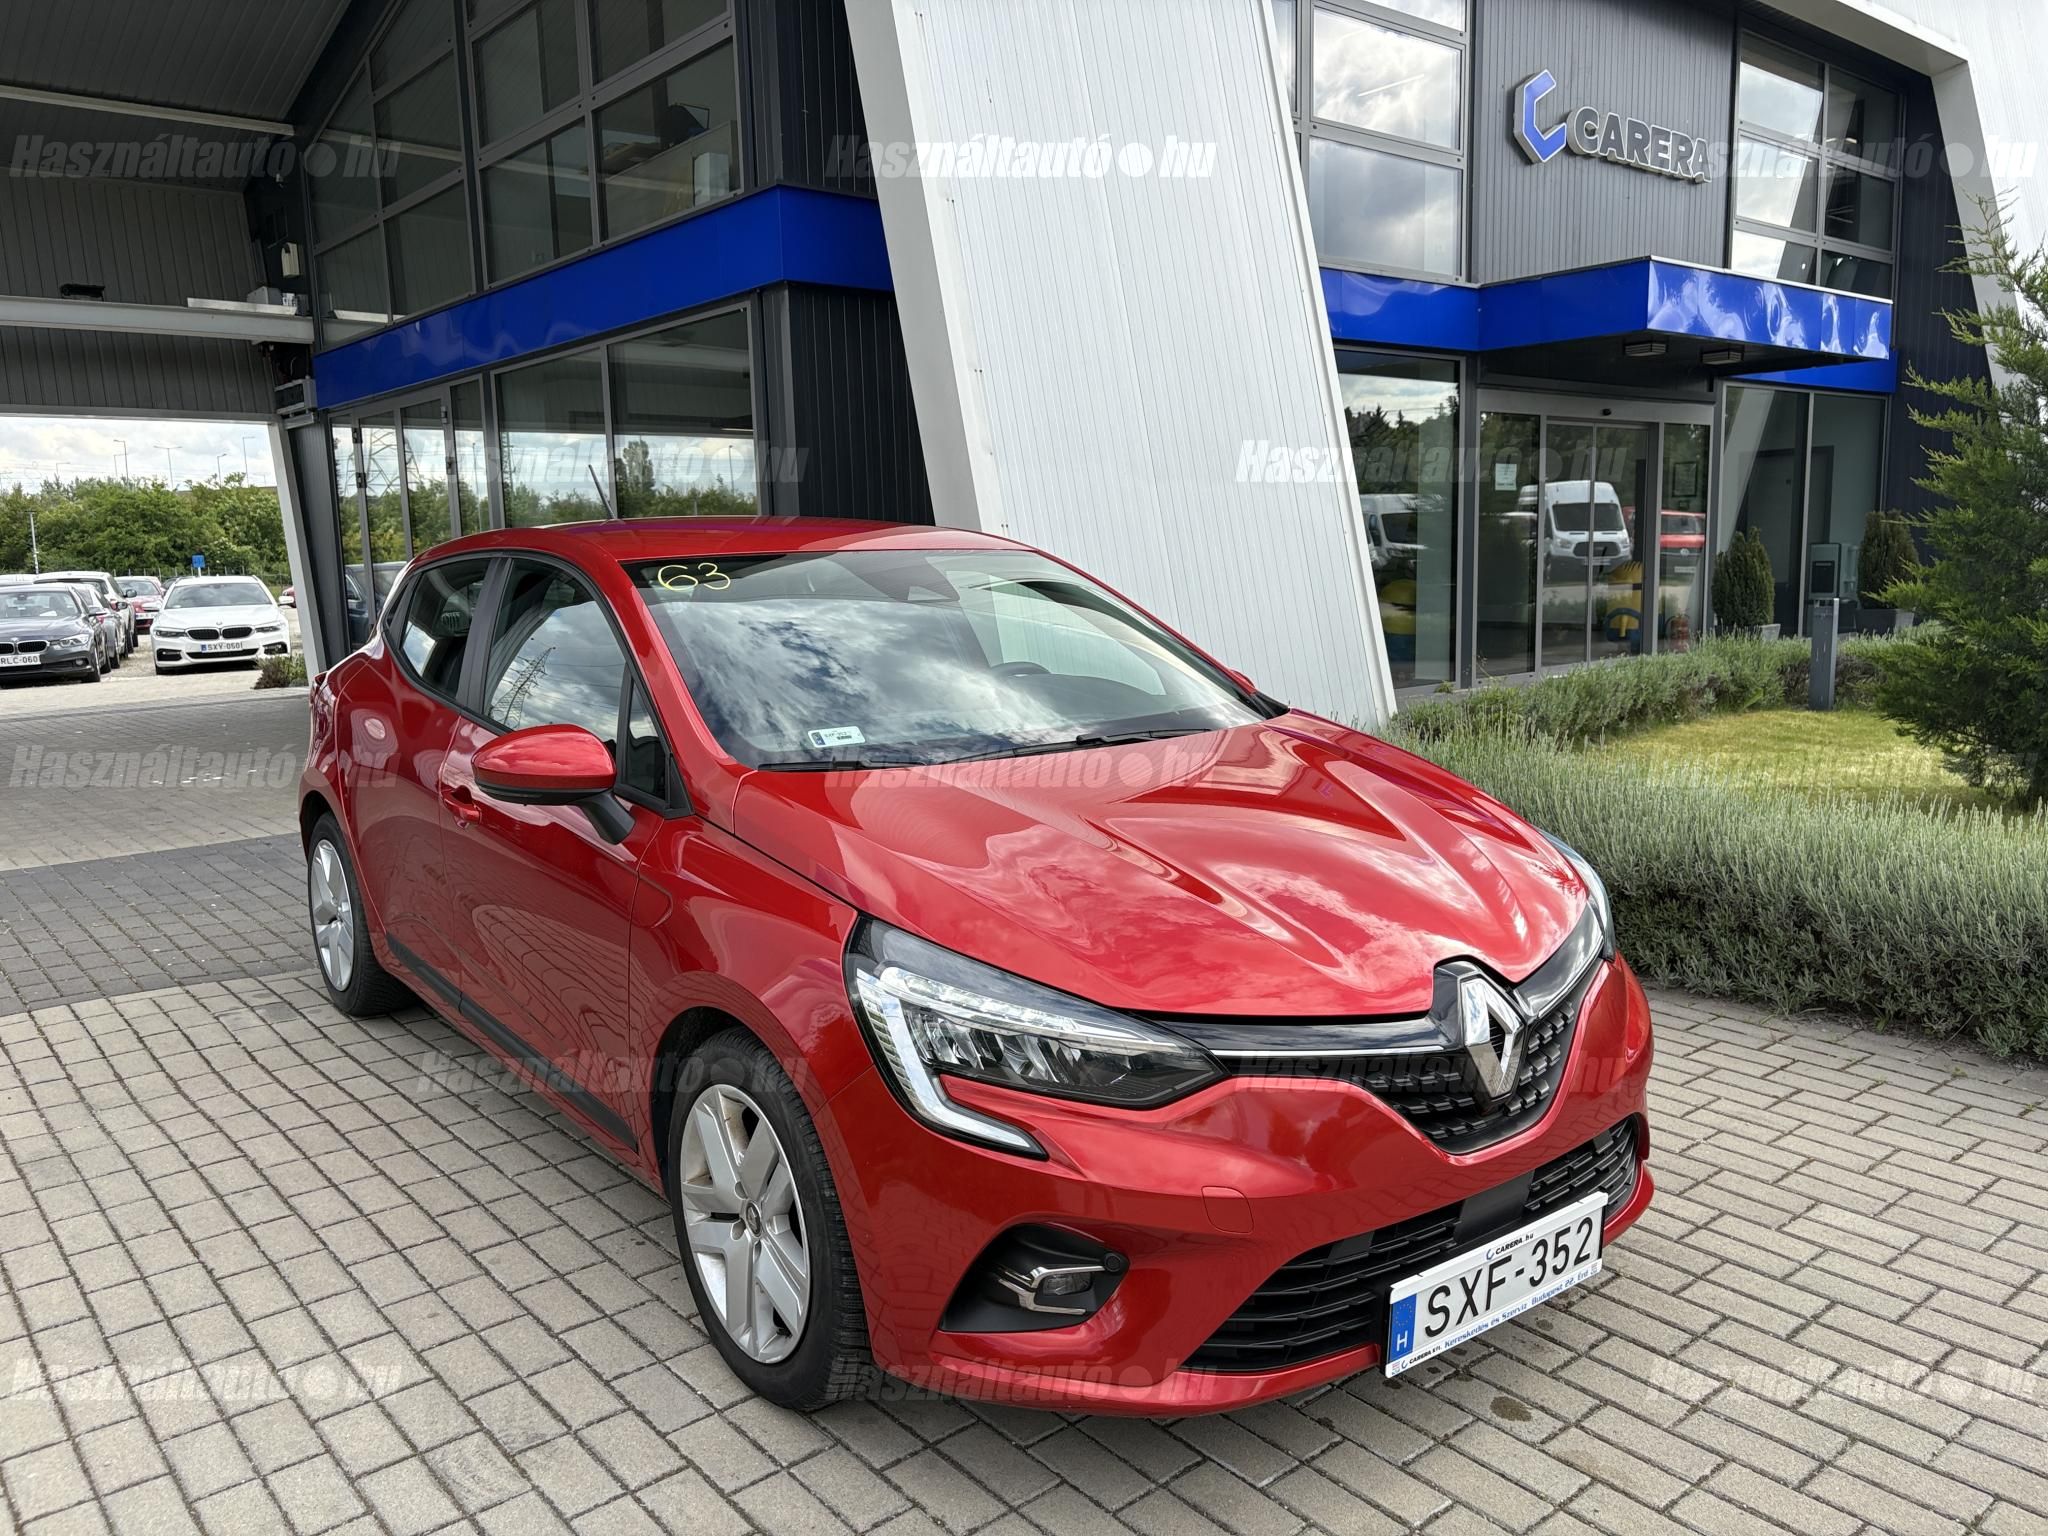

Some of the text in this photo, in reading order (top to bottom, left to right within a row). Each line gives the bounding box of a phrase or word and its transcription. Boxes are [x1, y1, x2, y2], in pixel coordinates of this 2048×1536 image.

[1568, 106, 1712, 183] CARERA
[657, 562, 731, 591] 63
[1425, 1216, 1594, 1338] SXF-352
[1396, 1330, 1409, 1352] H
